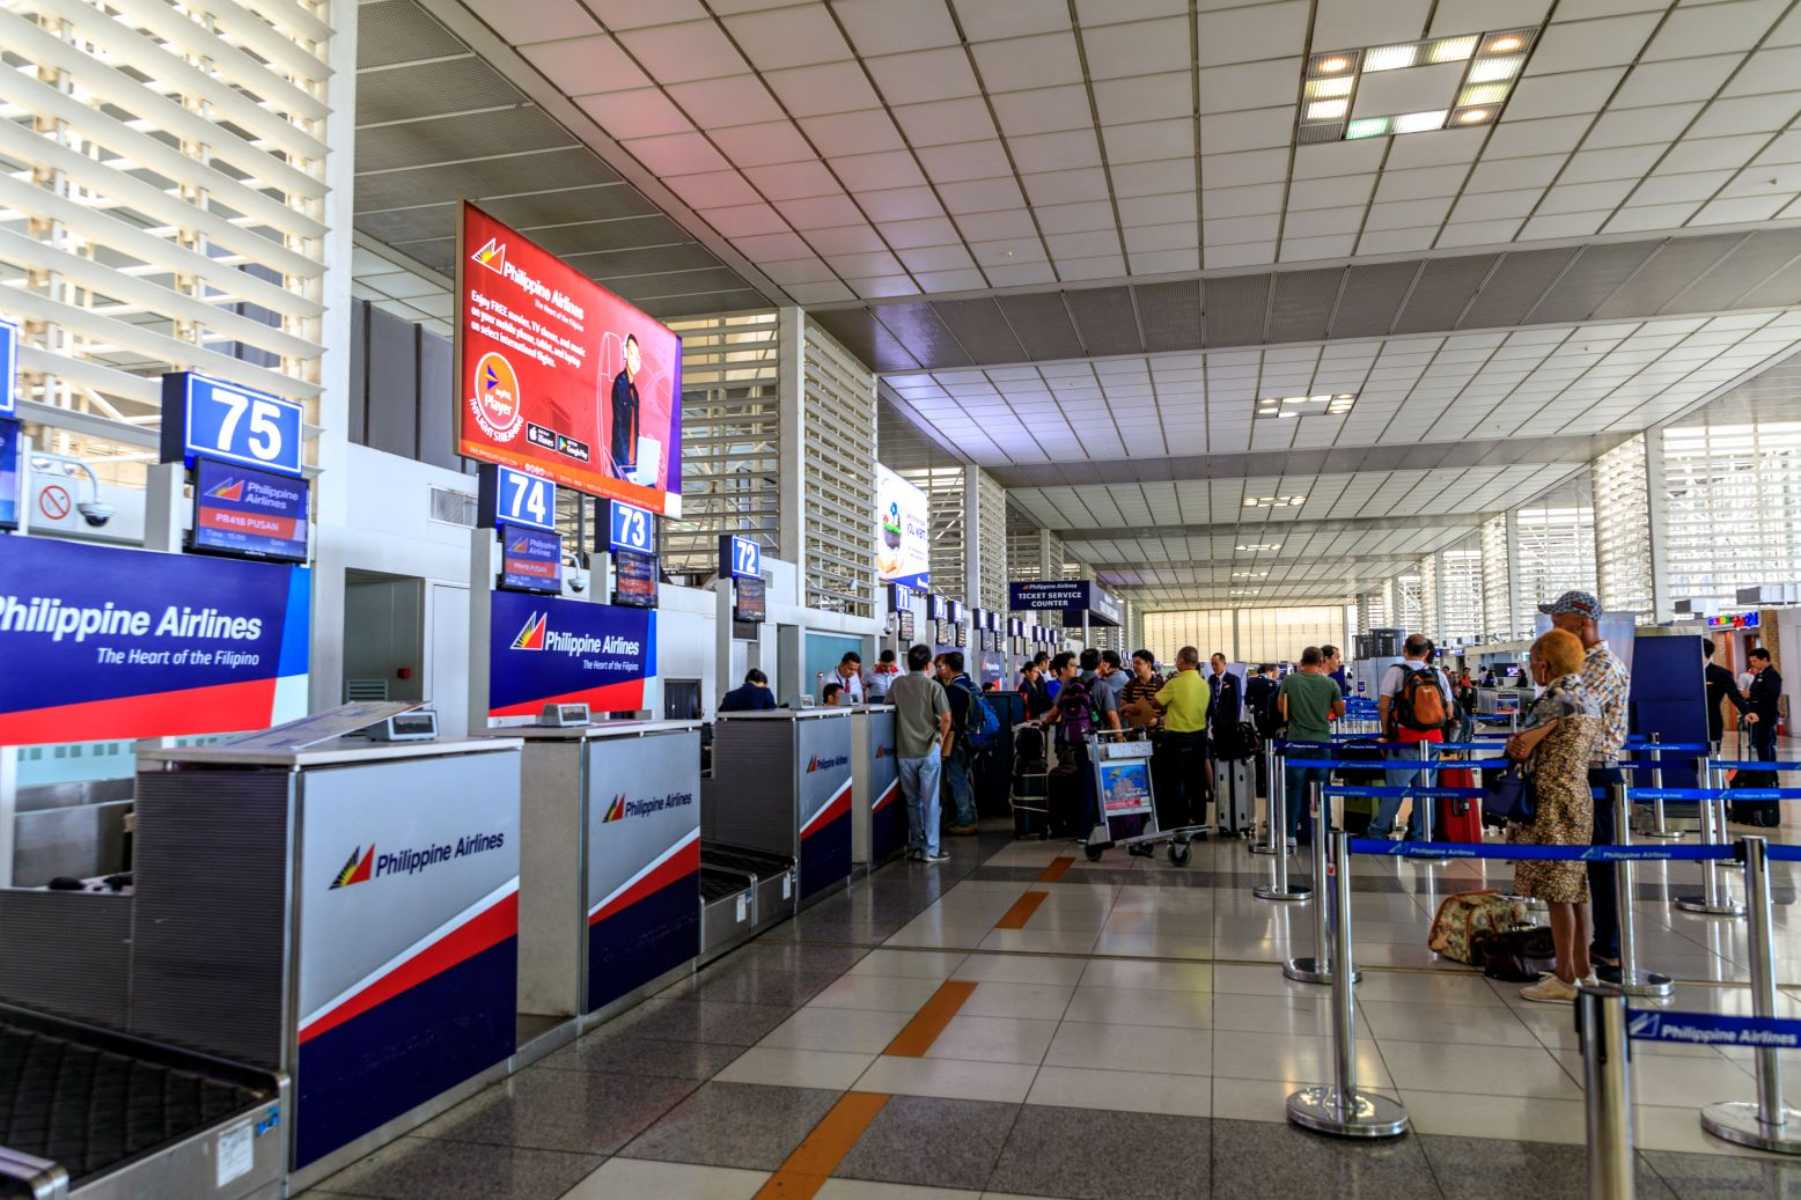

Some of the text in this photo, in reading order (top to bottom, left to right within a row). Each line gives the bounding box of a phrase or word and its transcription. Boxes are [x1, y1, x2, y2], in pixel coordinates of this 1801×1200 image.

[504, 261, 585, 320] Philippine Airlines
[490, 299, 509, 317] FREE
[485, 393, 512, 417] Player
[212, 387, 282, 461] 75
[245, 494, 287, 509] Airlines
[248, 481, 299, 501] Philippine
[508, 474, 546, 523] 74
[618, 506, 645, 546] 73
[736, 541, 756, 573] 72
[1018, 592, 1046, 600] TICKET
[1031, 600, 1069, 608] COUNTER
[0, 595, 263, 642] hilippine Airlines
[545, 631, 640, 657] Philippine Airlines
[97, 647, 260, 669] The Heart of the Filipino
[583, 660, 593, 670] The
[625, 792, 692, 818] Philippine Airlines
[376, 832, 504, 877] Philippine Airlines
[1661, 1024, 1797, 1045] Philippine Airlines
